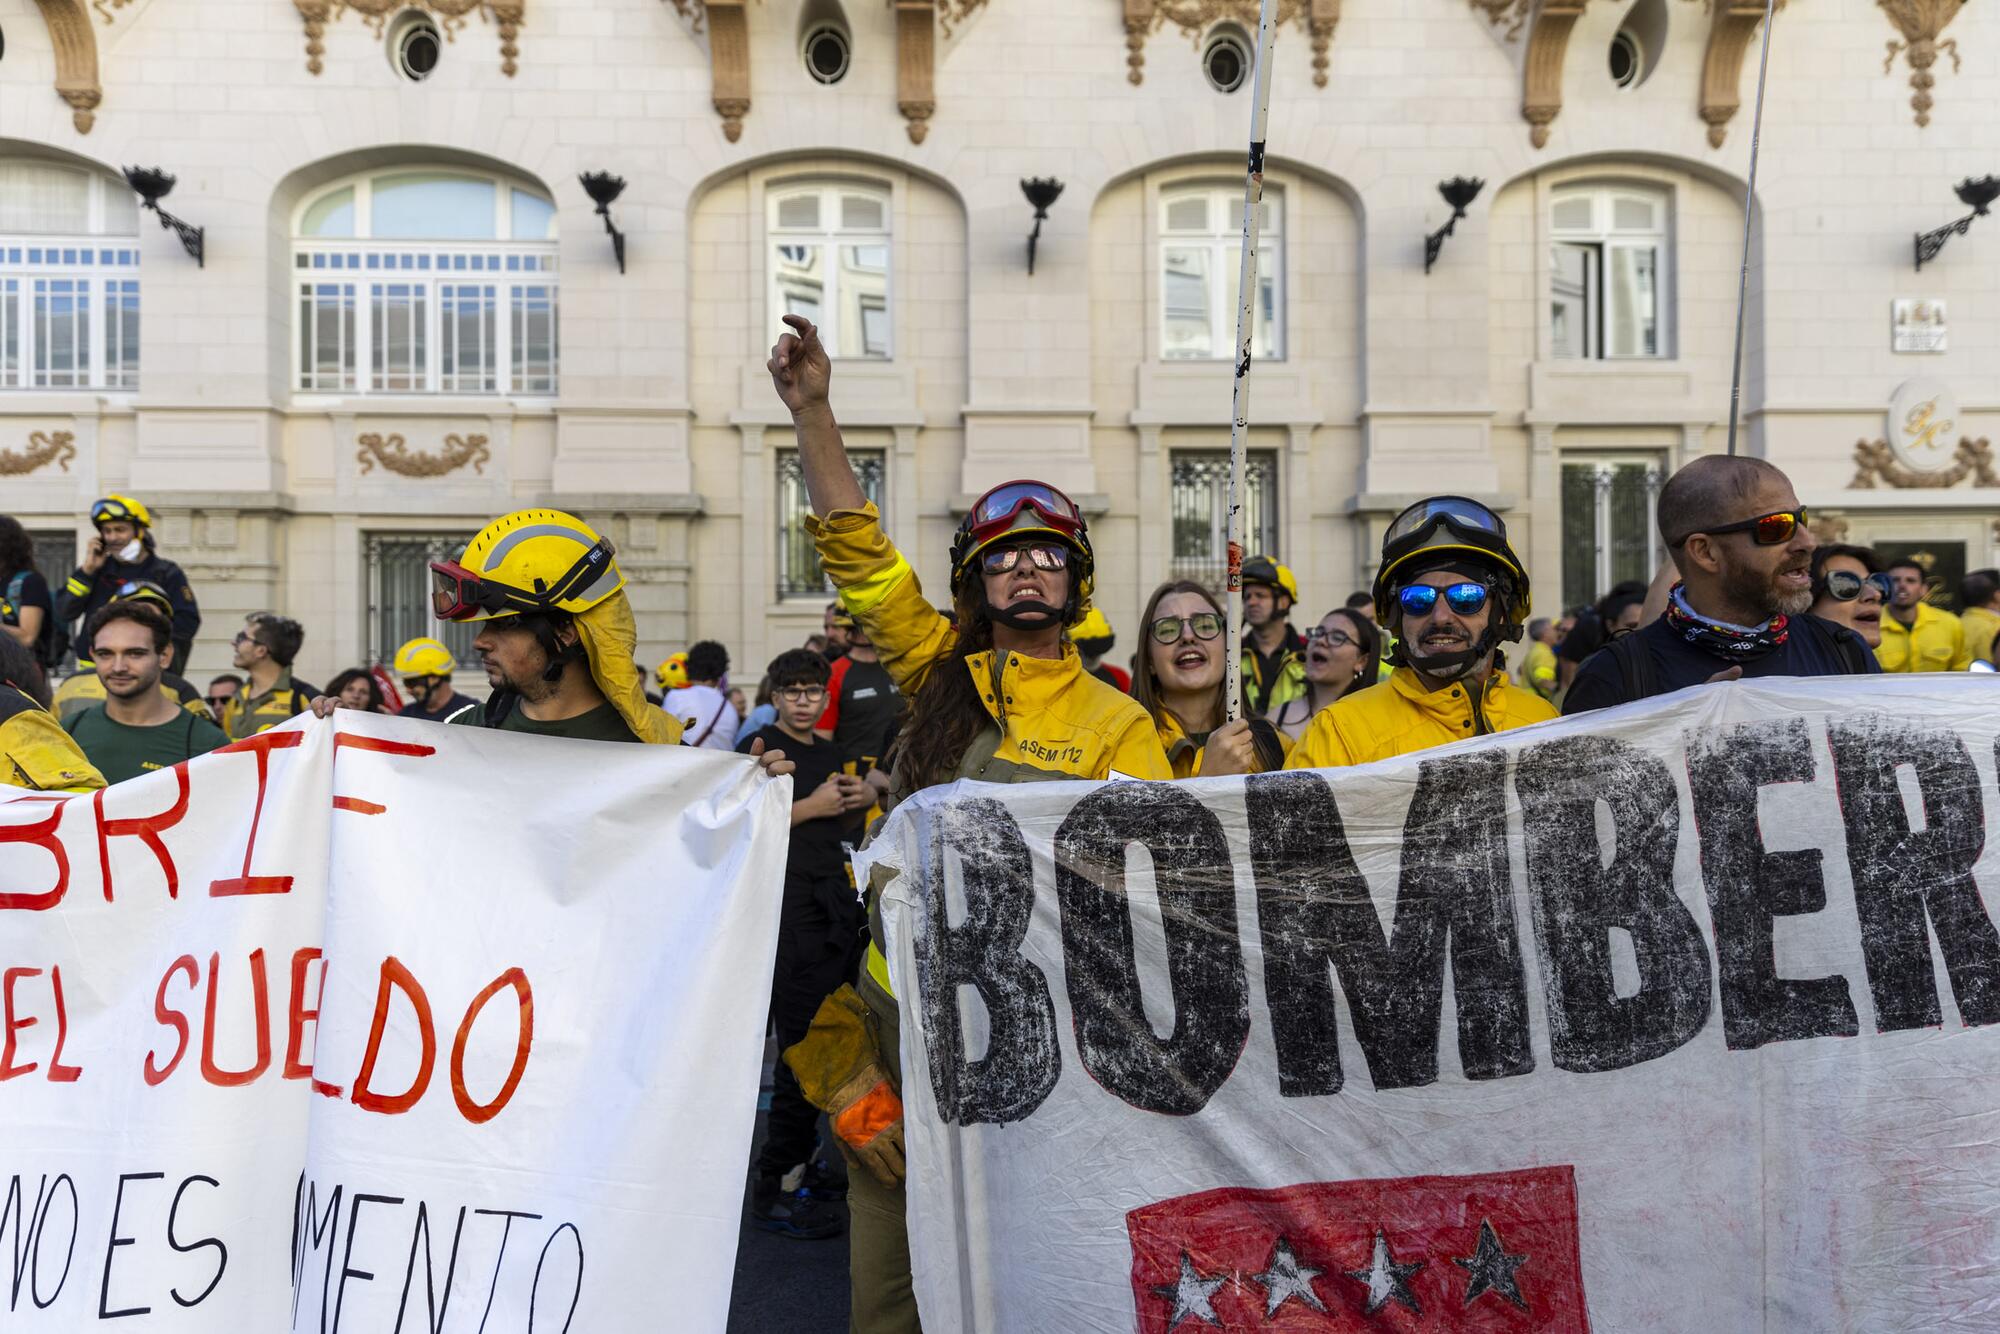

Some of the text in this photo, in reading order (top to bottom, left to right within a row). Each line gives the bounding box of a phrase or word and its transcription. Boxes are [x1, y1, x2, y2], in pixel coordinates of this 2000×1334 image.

[1020, 740, 1084, 763] ASEM 112
[914, 712, 2000, 1127] BOMBER
[0, 964, 83, 1082] EL
[0, 1173, 78, 1312] NO
[99, 1172, 228, 1319] ES
